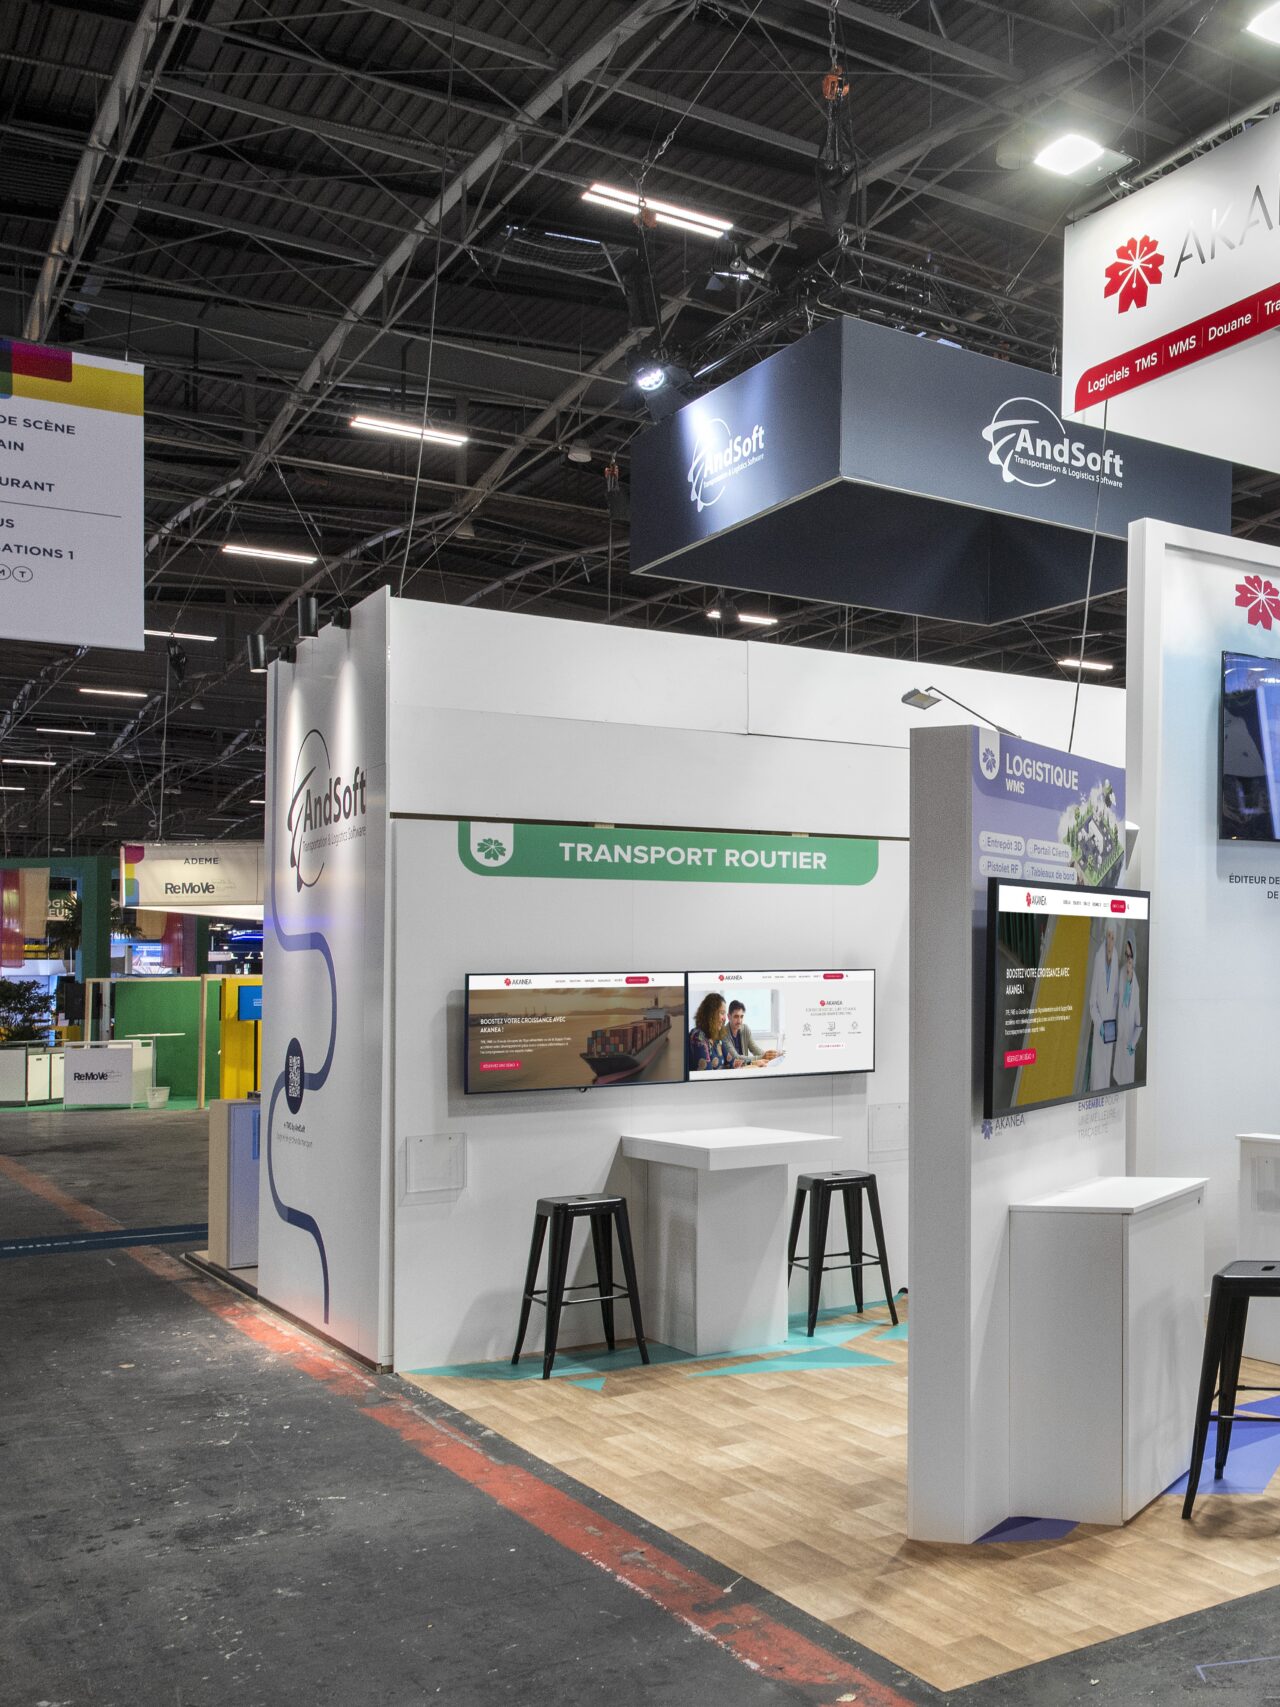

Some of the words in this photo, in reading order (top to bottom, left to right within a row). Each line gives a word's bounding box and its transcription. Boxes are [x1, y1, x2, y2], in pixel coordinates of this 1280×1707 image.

[1087, 365, 1130, 393] Logiciels
[1135, 352, 1158, 372] TMS
[1168, 335, 1197, 358] WMS
[1208, 312, 1252, 341] Douane
[23, 418, 76, 435] SCÈNE
[703, 424, 765, 479] AndSoft
[1015, 428, 1124, 478] AndSoft
[1014, 454, 1061, 473] Transportation
[1062, 466, 1067, 475] &
[1068, 467, 1095, 482] Logistics
[69, 551, 74, 560] 1
[1006, 753, 1079, 791] LOGISTIQUE
[1005, 778, 1025, 794] WMS
[303, 766, 367, 833] AndSoft
[987, 837, 1013, 851] Entrepôt
[1014, 840, 1023, 852] 3D
[183, 857, 219, 865] ADEME
[558, 841, 718, 868] TRANSPORT
[725, 848, 827, 870] ROUTIER
[987, 861, 1010, 873] Pistolet
[1011, 863, 1019, 874] RF
[1031, 866, 1054, 878] Tableaux
[1063, 871, 1075, 881] bord
[1228, 872, 1267, 885] ÉDITEUR
[1268, 876, 1280, 886] DE
[164, 882, 215, 895] ReMoVe
[1267, 890, 1279, 899] DE
[521, 1016, 553, 1024] CROISSANCE
[73, 1072, 108, 1081] ReMoVe
[1078, 1097, 1105, 1111] ENSEMBLE
[994, 1114, 1026, 1131] AKANEA
